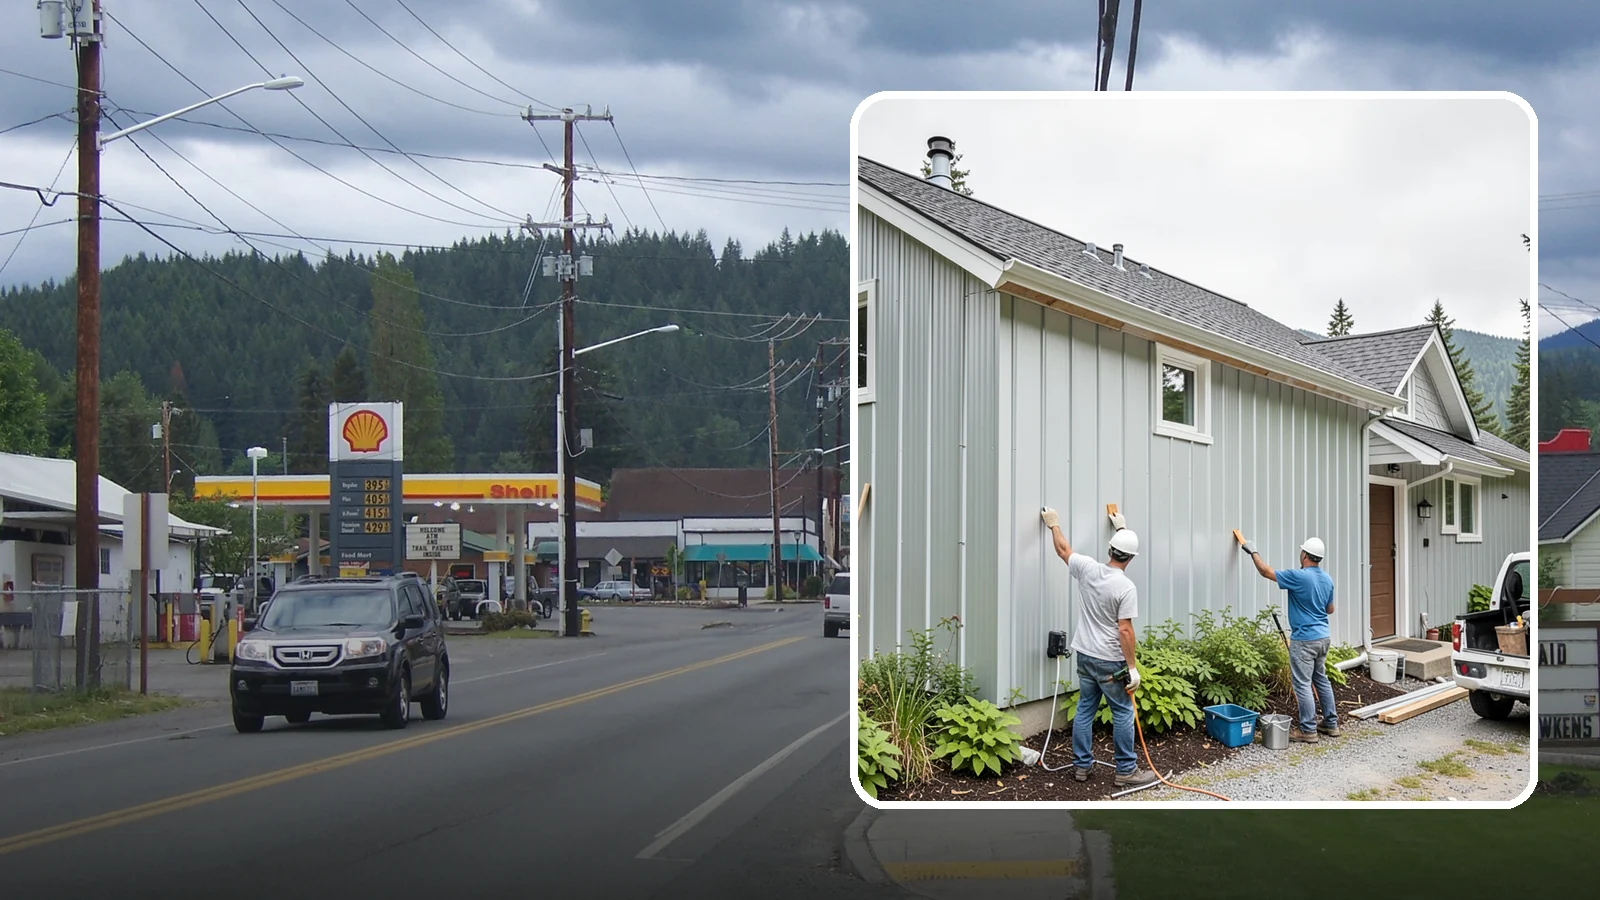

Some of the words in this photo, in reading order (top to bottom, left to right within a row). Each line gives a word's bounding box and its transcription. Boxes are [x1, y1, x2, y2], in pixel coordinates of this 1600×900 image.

[365, 480, 384, 490] 395
[490, 484, 547, 499] Shell
[365, 494, 384, 504] 405
[365, 508, 384, 518] 415
[365, 522, 384, 532] 429
